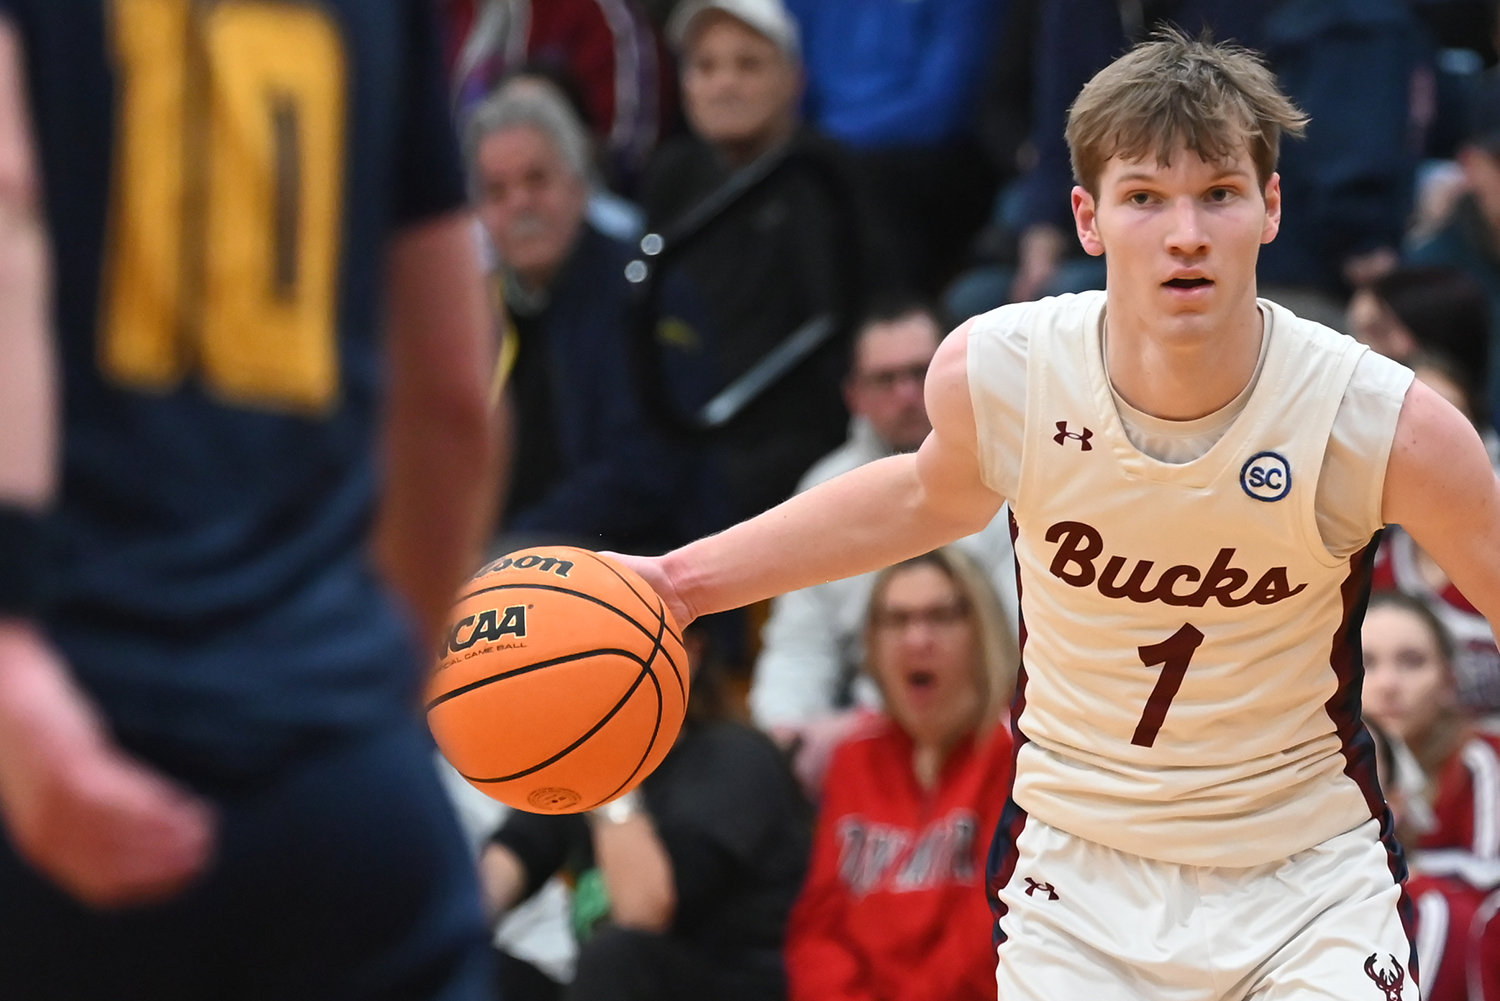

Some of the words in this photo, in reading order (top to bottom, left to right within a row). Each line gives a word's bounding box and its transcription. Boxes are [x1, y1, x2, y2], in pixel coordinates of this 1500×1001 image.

[102, 0, 342, 412] 10
[1249, 466, 1282, 490] SC
[1045, 521, 1309, 608] Bucks
[464, 646, 494, 660] GAME
[496, 642, 527, 652] BALL
[1131, 622, 1205, 748] 1
